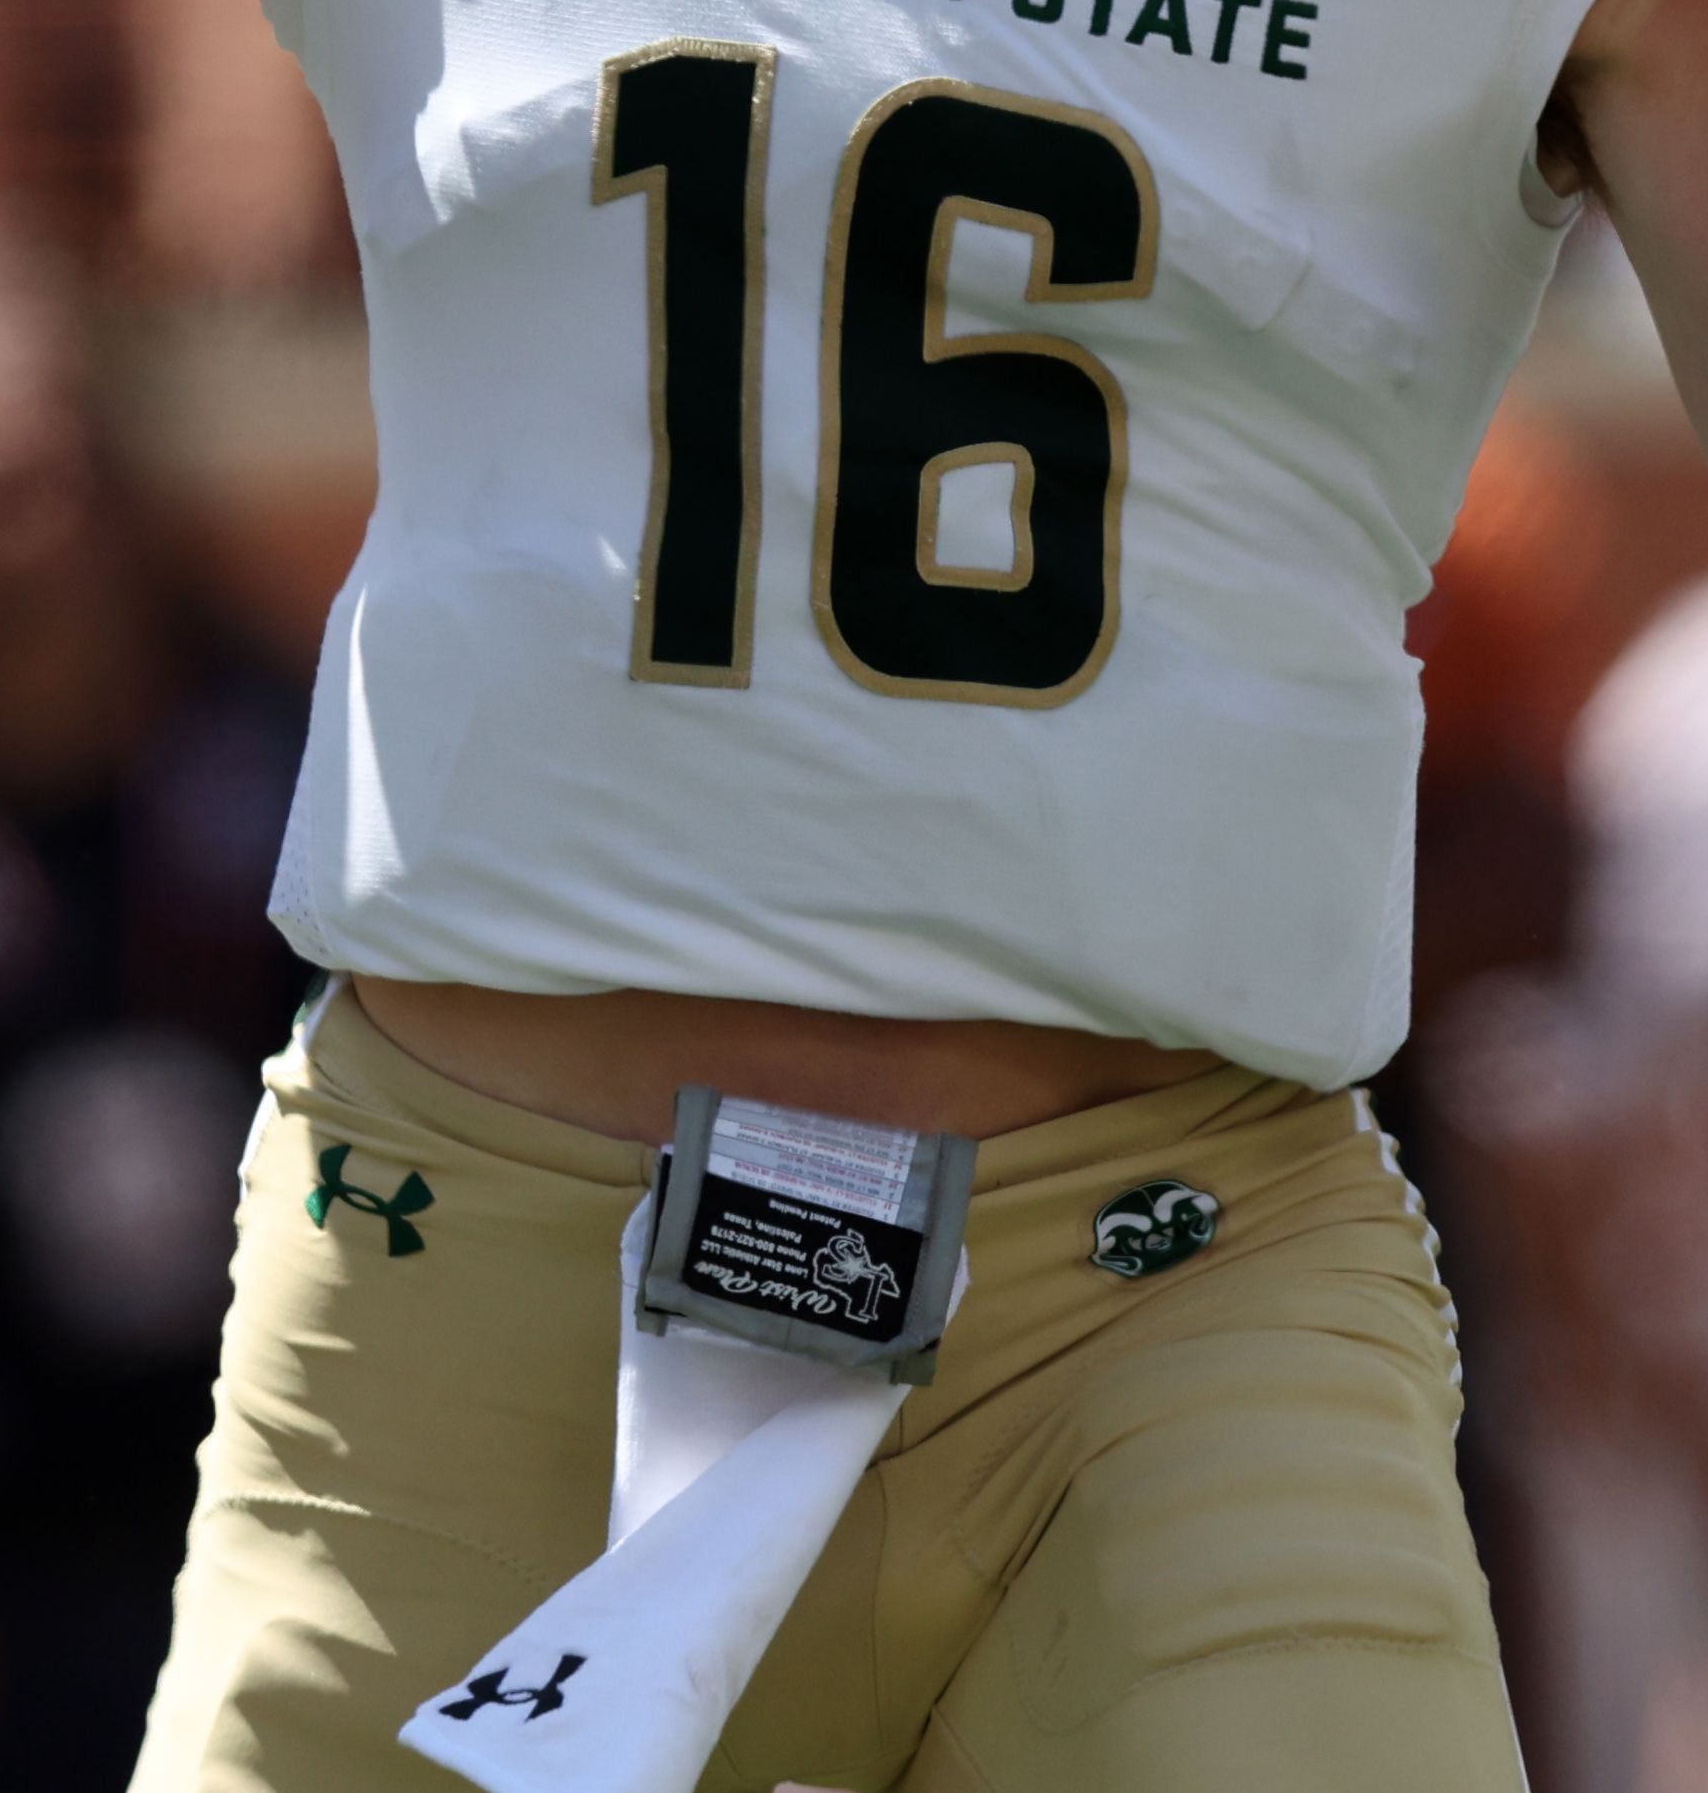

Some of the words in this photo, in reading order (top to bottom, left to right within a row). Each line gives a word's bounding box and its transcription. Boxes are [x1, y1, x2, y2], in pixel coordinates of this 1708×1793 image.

[591, 34, 1161, 711] 16
[808, 1209, 842, 1229] Patent
[700, 1238, 721, 1254] LLC
[776, 1245, 807, 1263] Phone
[763, 1257, 785, 1273] Star
[784, 1263, 809, 1279] Lone
[693, 1260, 759, 1294] Plan
[758, 1279, 837, 1315] Wrist
